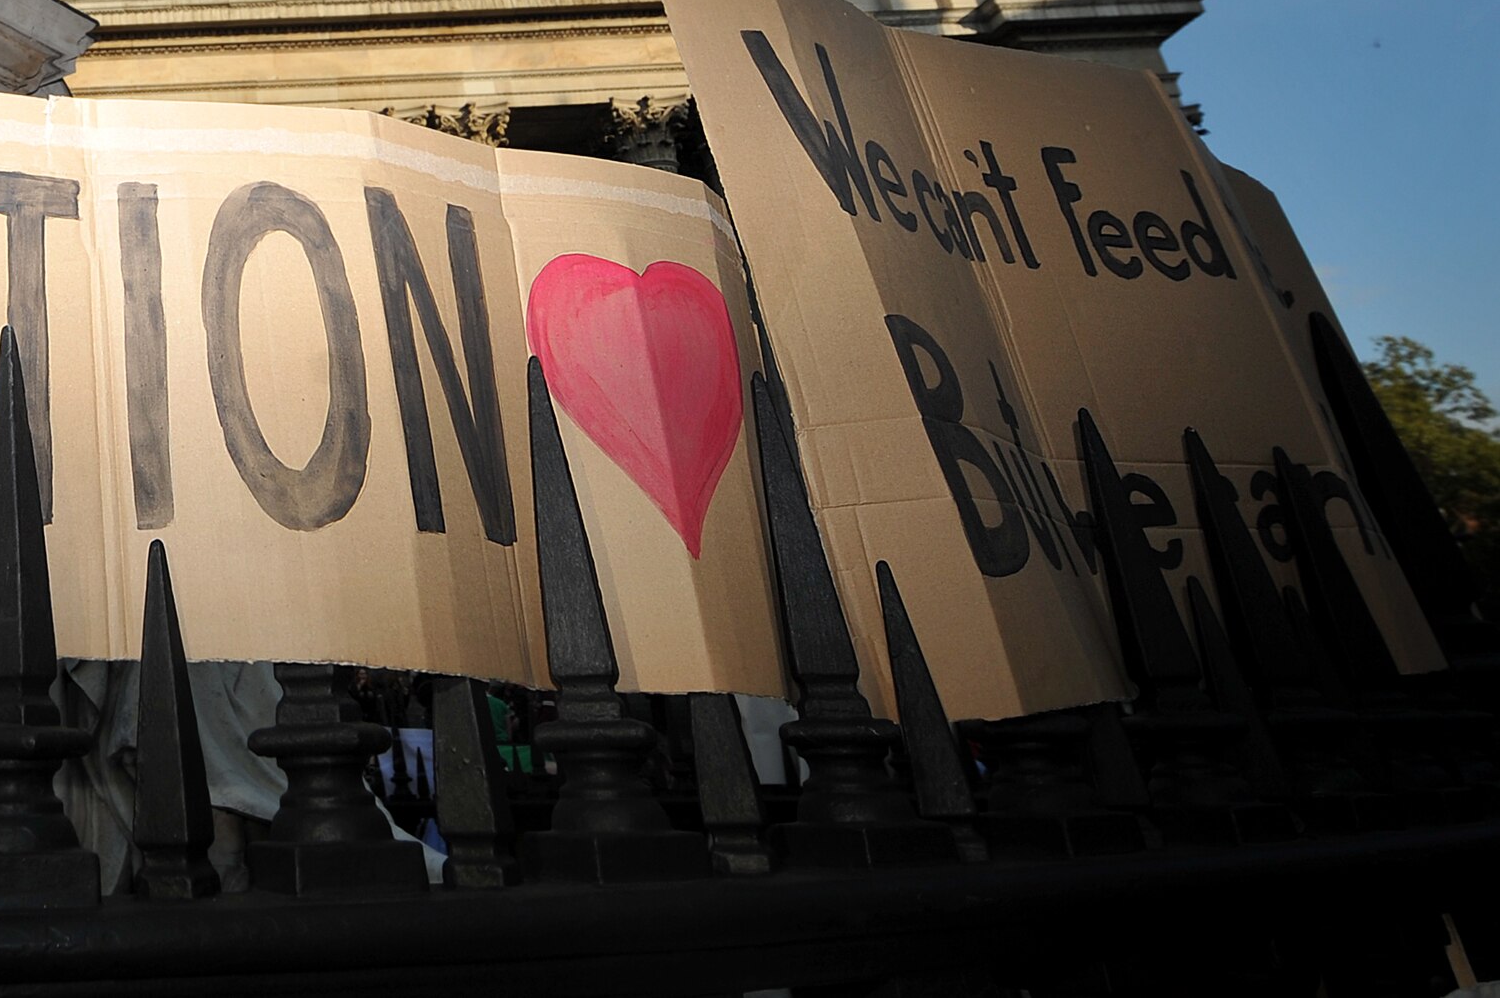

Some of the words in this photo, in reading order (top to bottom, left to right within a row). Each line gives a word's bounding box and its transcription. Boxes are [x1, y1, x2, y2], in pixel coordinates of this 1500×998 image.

[741, 30, 918, 232] We
[911, 140, 1042, 269] can't
[1041, 146, 1236, 282] Feed
